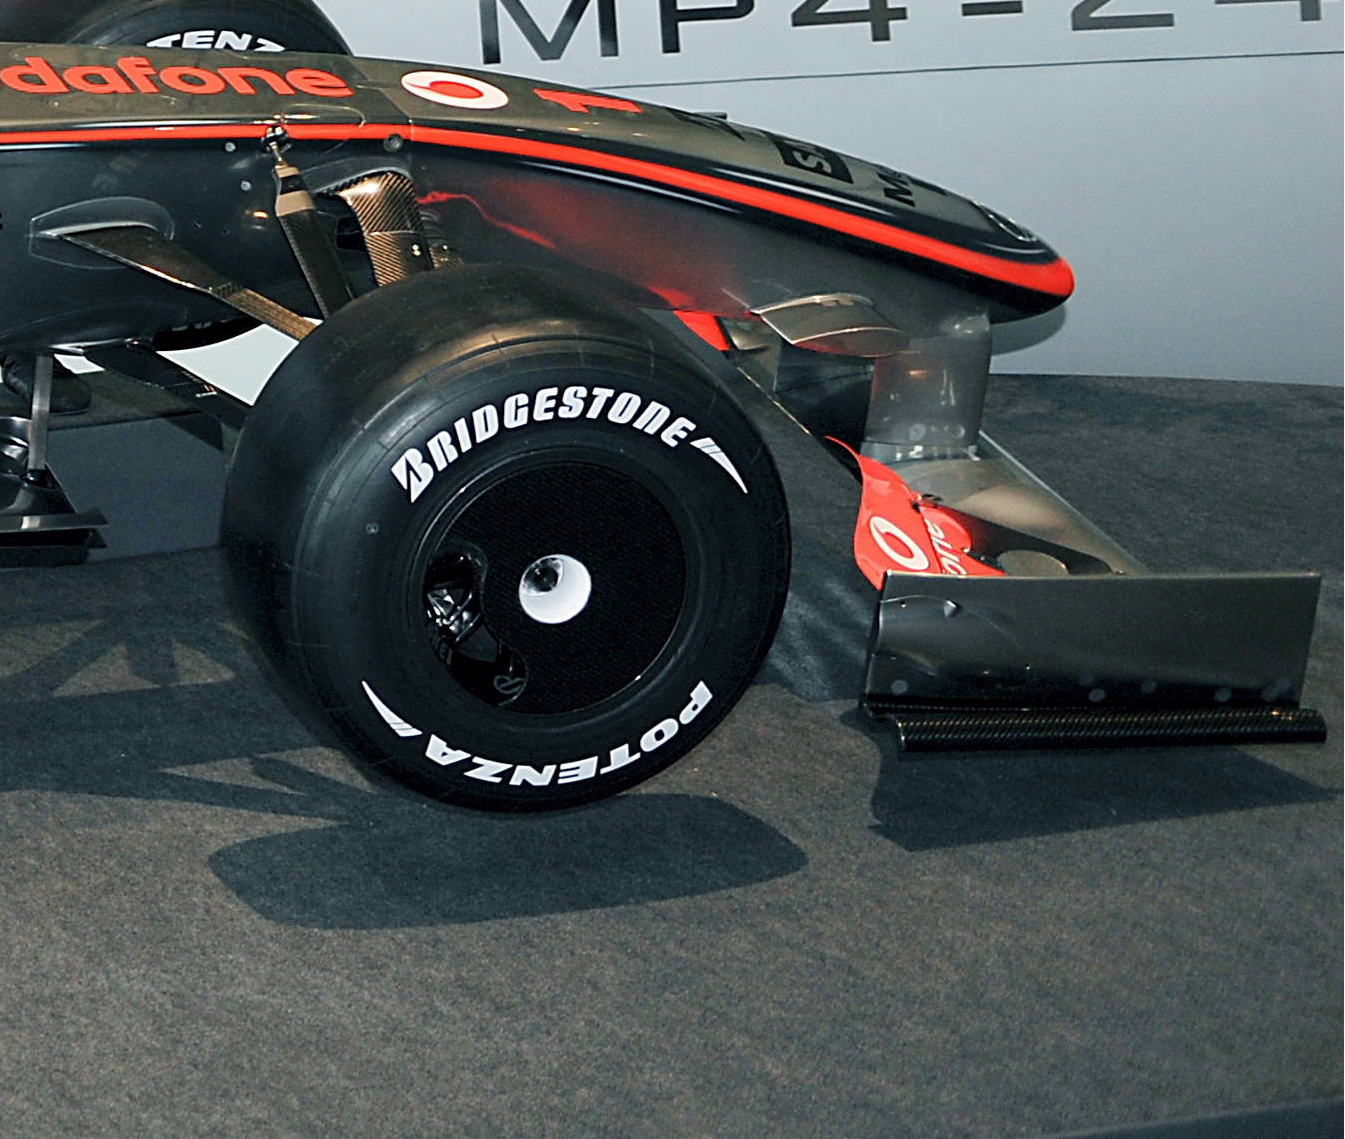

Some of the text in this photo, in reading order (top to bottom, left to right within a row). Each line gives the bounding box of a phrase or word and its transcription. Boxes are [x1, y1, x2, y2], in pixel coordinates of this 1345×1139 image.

[146, 30, 286, 52] TENZ
[391, 386, 696, 503] BRIDGESTONE
[424, 680, 713, 786] POTENZA
